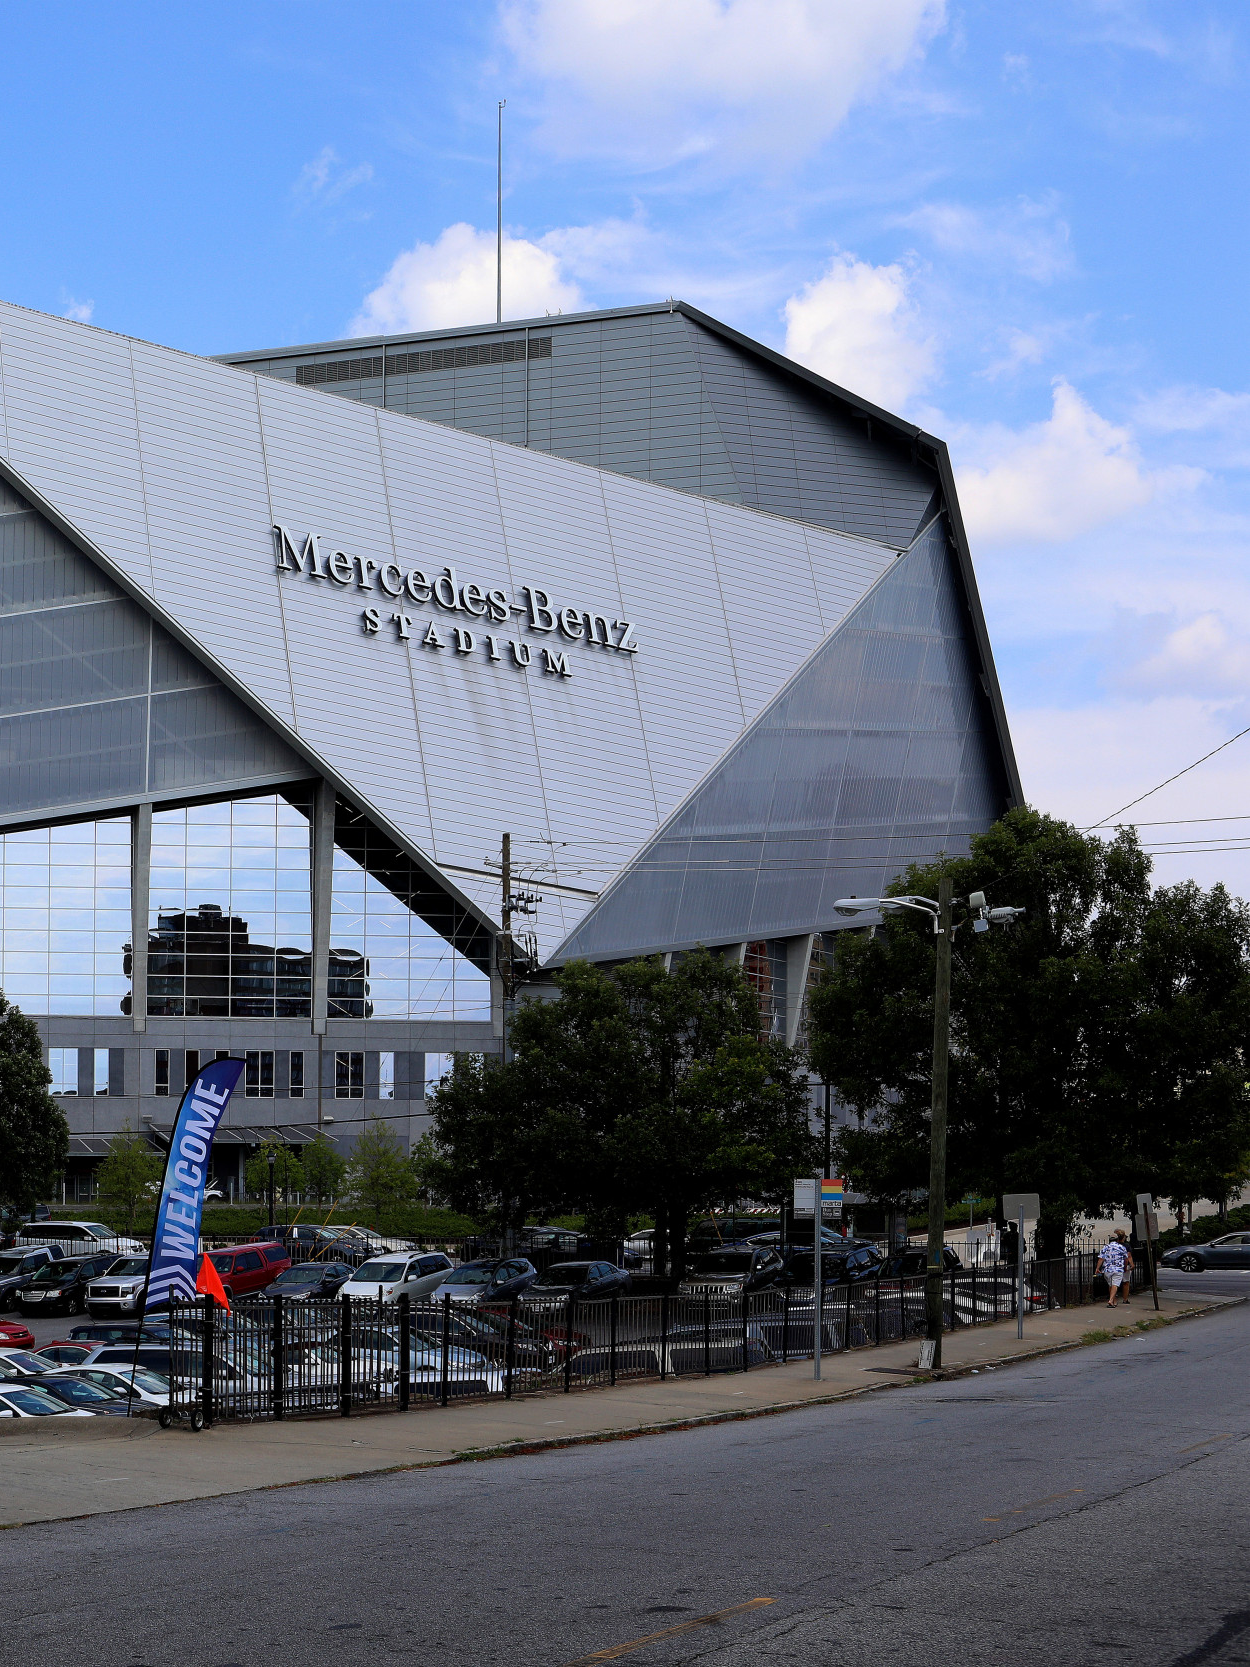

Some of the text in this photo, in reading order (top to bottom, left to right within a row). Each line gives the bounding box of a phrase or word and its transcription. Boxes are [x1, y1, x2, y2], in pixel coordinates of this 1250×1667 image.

[273, 524, 639, 654] Mercedes-Benz
[363, 607, 573, 678] STADIUM
[161, 1079, 230, 1260] WELCOME
